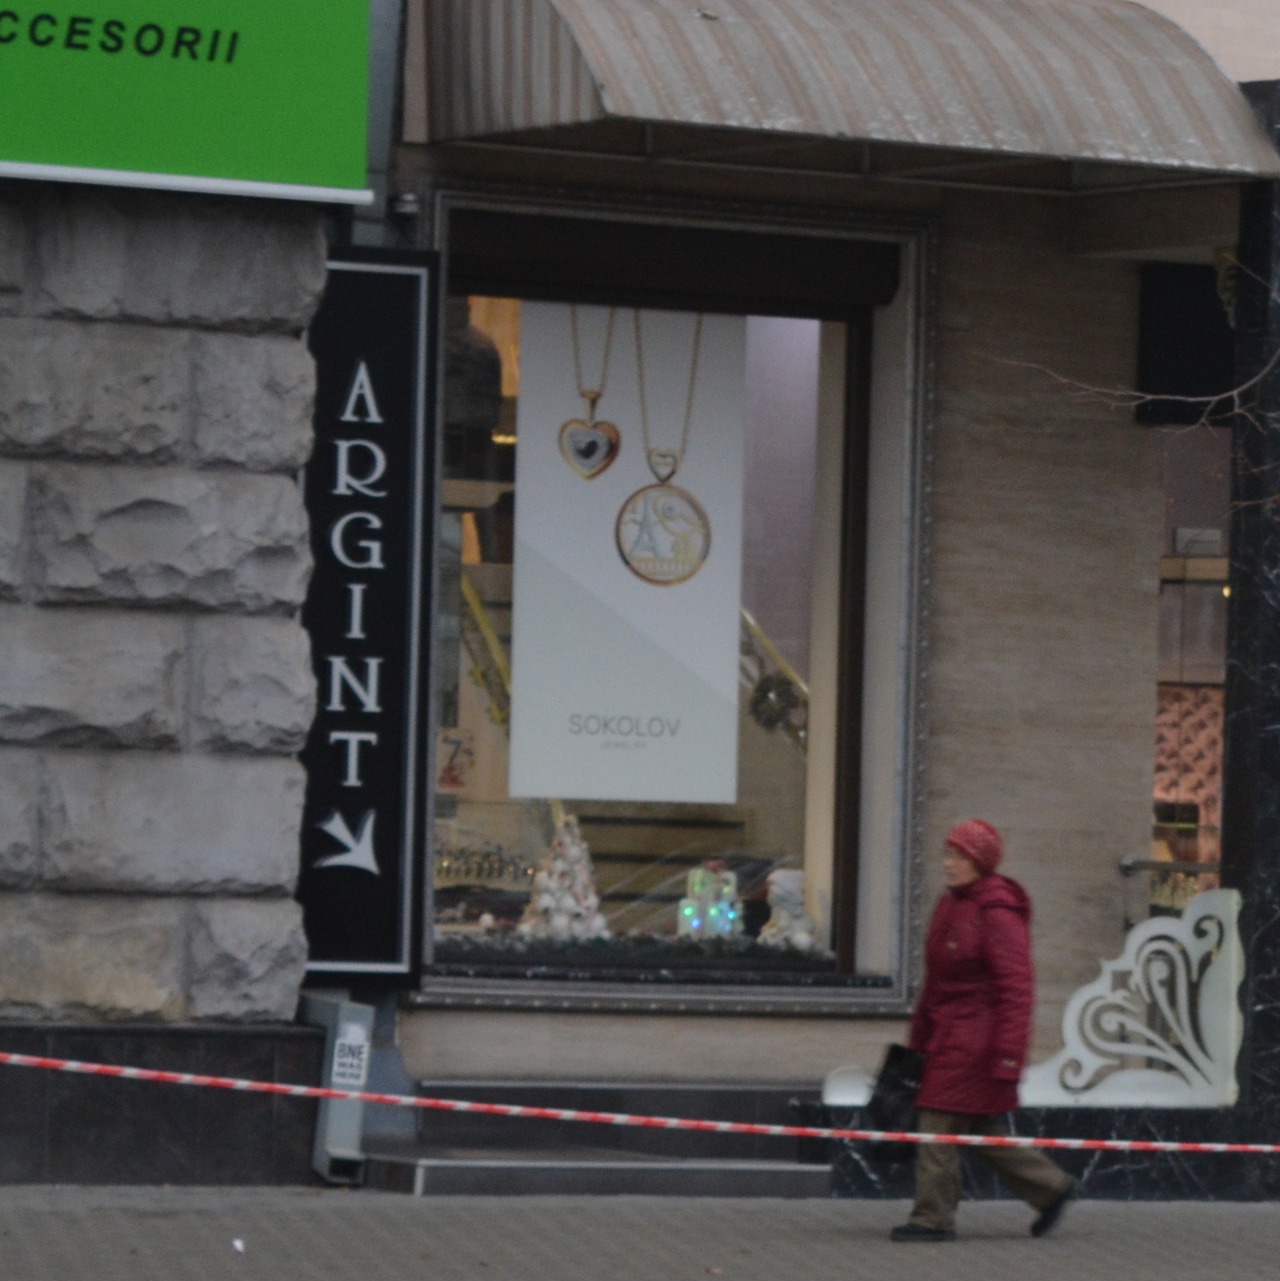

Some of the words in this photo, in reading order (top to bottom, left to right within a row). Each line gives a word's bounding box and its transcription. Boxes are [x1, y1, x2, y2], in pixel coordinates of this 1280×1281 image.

[0, 9, 239, 63] CCESORII
[327, 359, 388, 788] ARGINT
[567, 713, 681, 738] SOKOLOV
